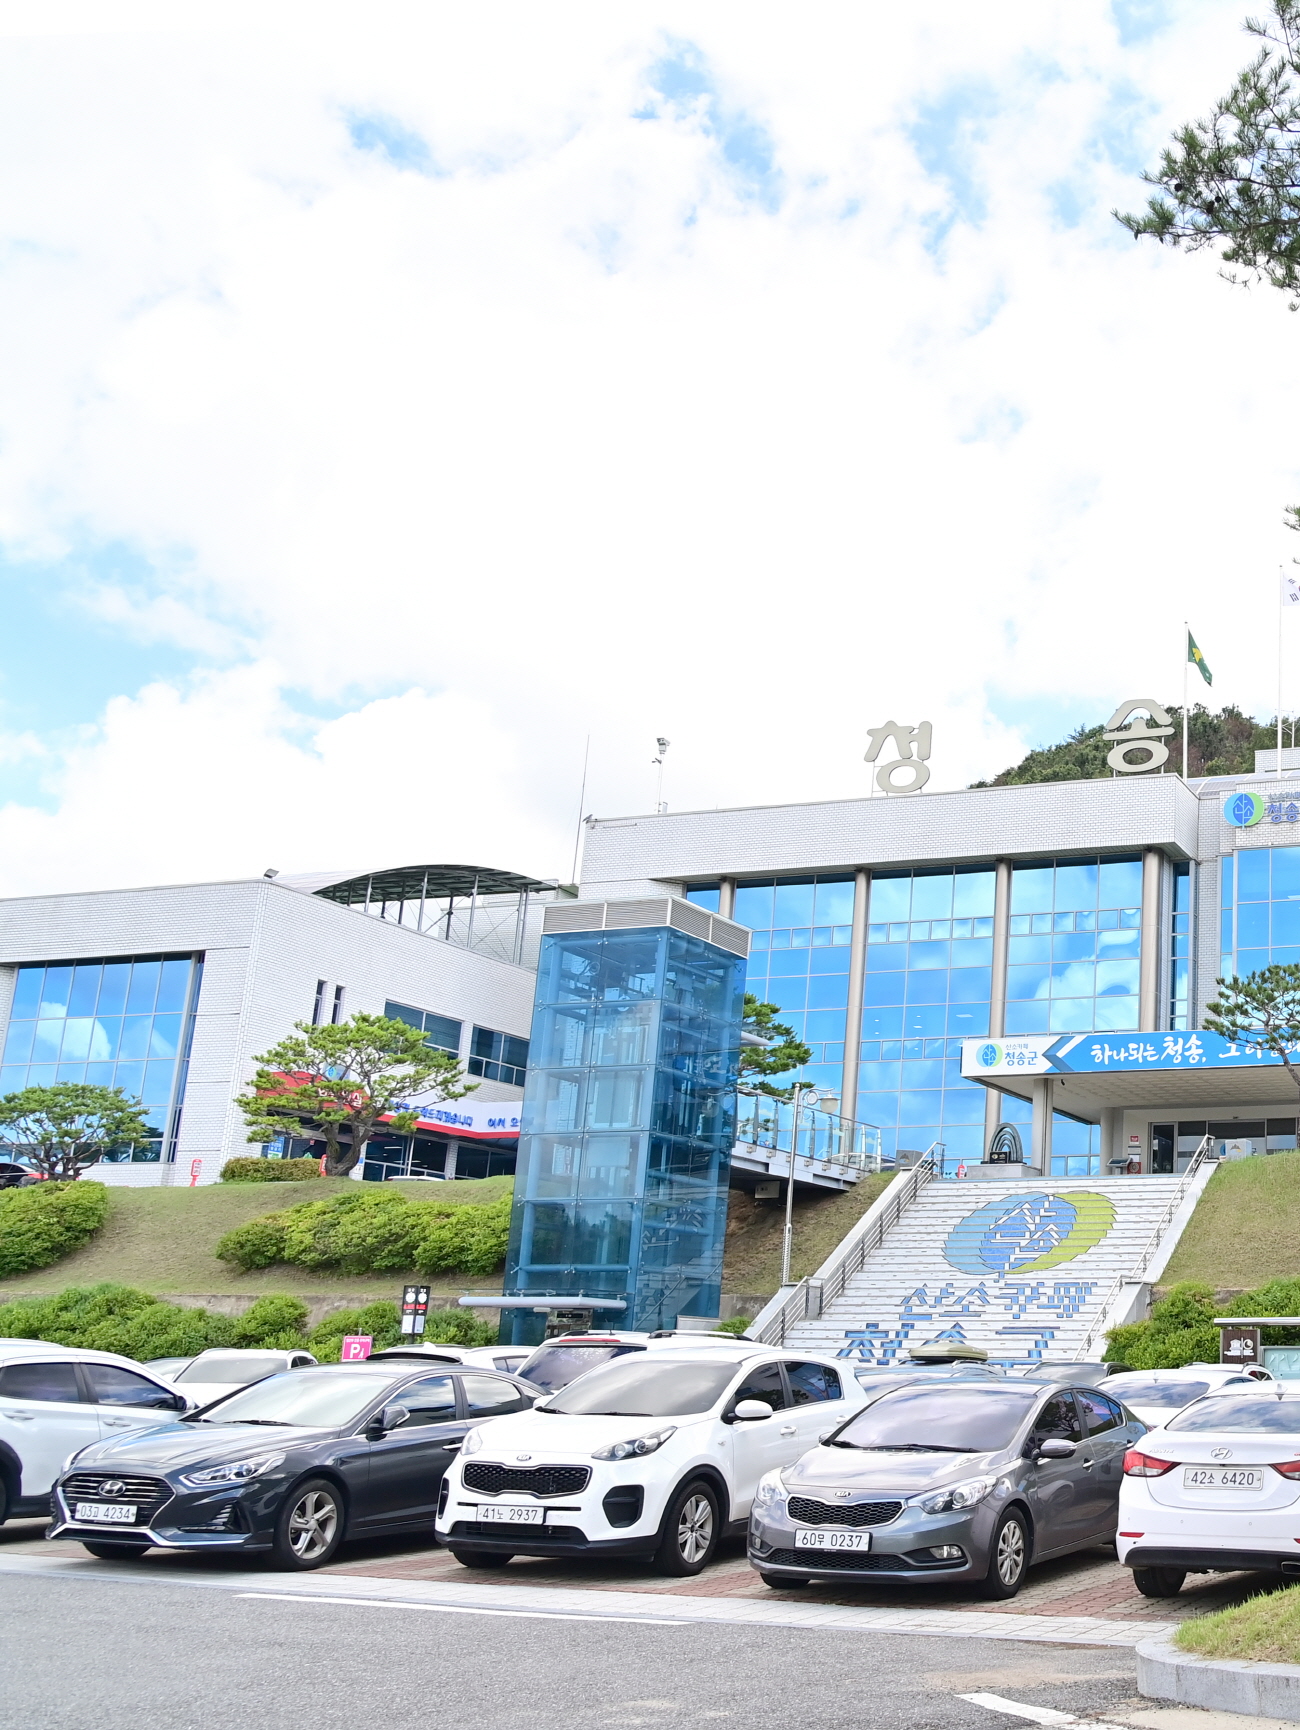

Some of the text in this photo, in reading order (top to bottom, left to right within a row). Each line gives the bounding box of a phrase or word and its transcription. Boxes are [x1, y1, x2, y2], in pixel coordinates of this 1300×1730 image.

[1005, 1043, 1029, 1051] 산소카페
[1090, 1043, 1160, 1065] 하나되는
[1005, 1051, 1038, 1066] 청송군
[898, 1281, 1098, 1320] 산소카페
[1190, 1471, 1255, 1486] 42소 6420
[103, 1507, 130, 1520] 4234
[482, 1507, 538, 1521] 41노 2937
[801, 1532, 863, 1548] 60무 0237
